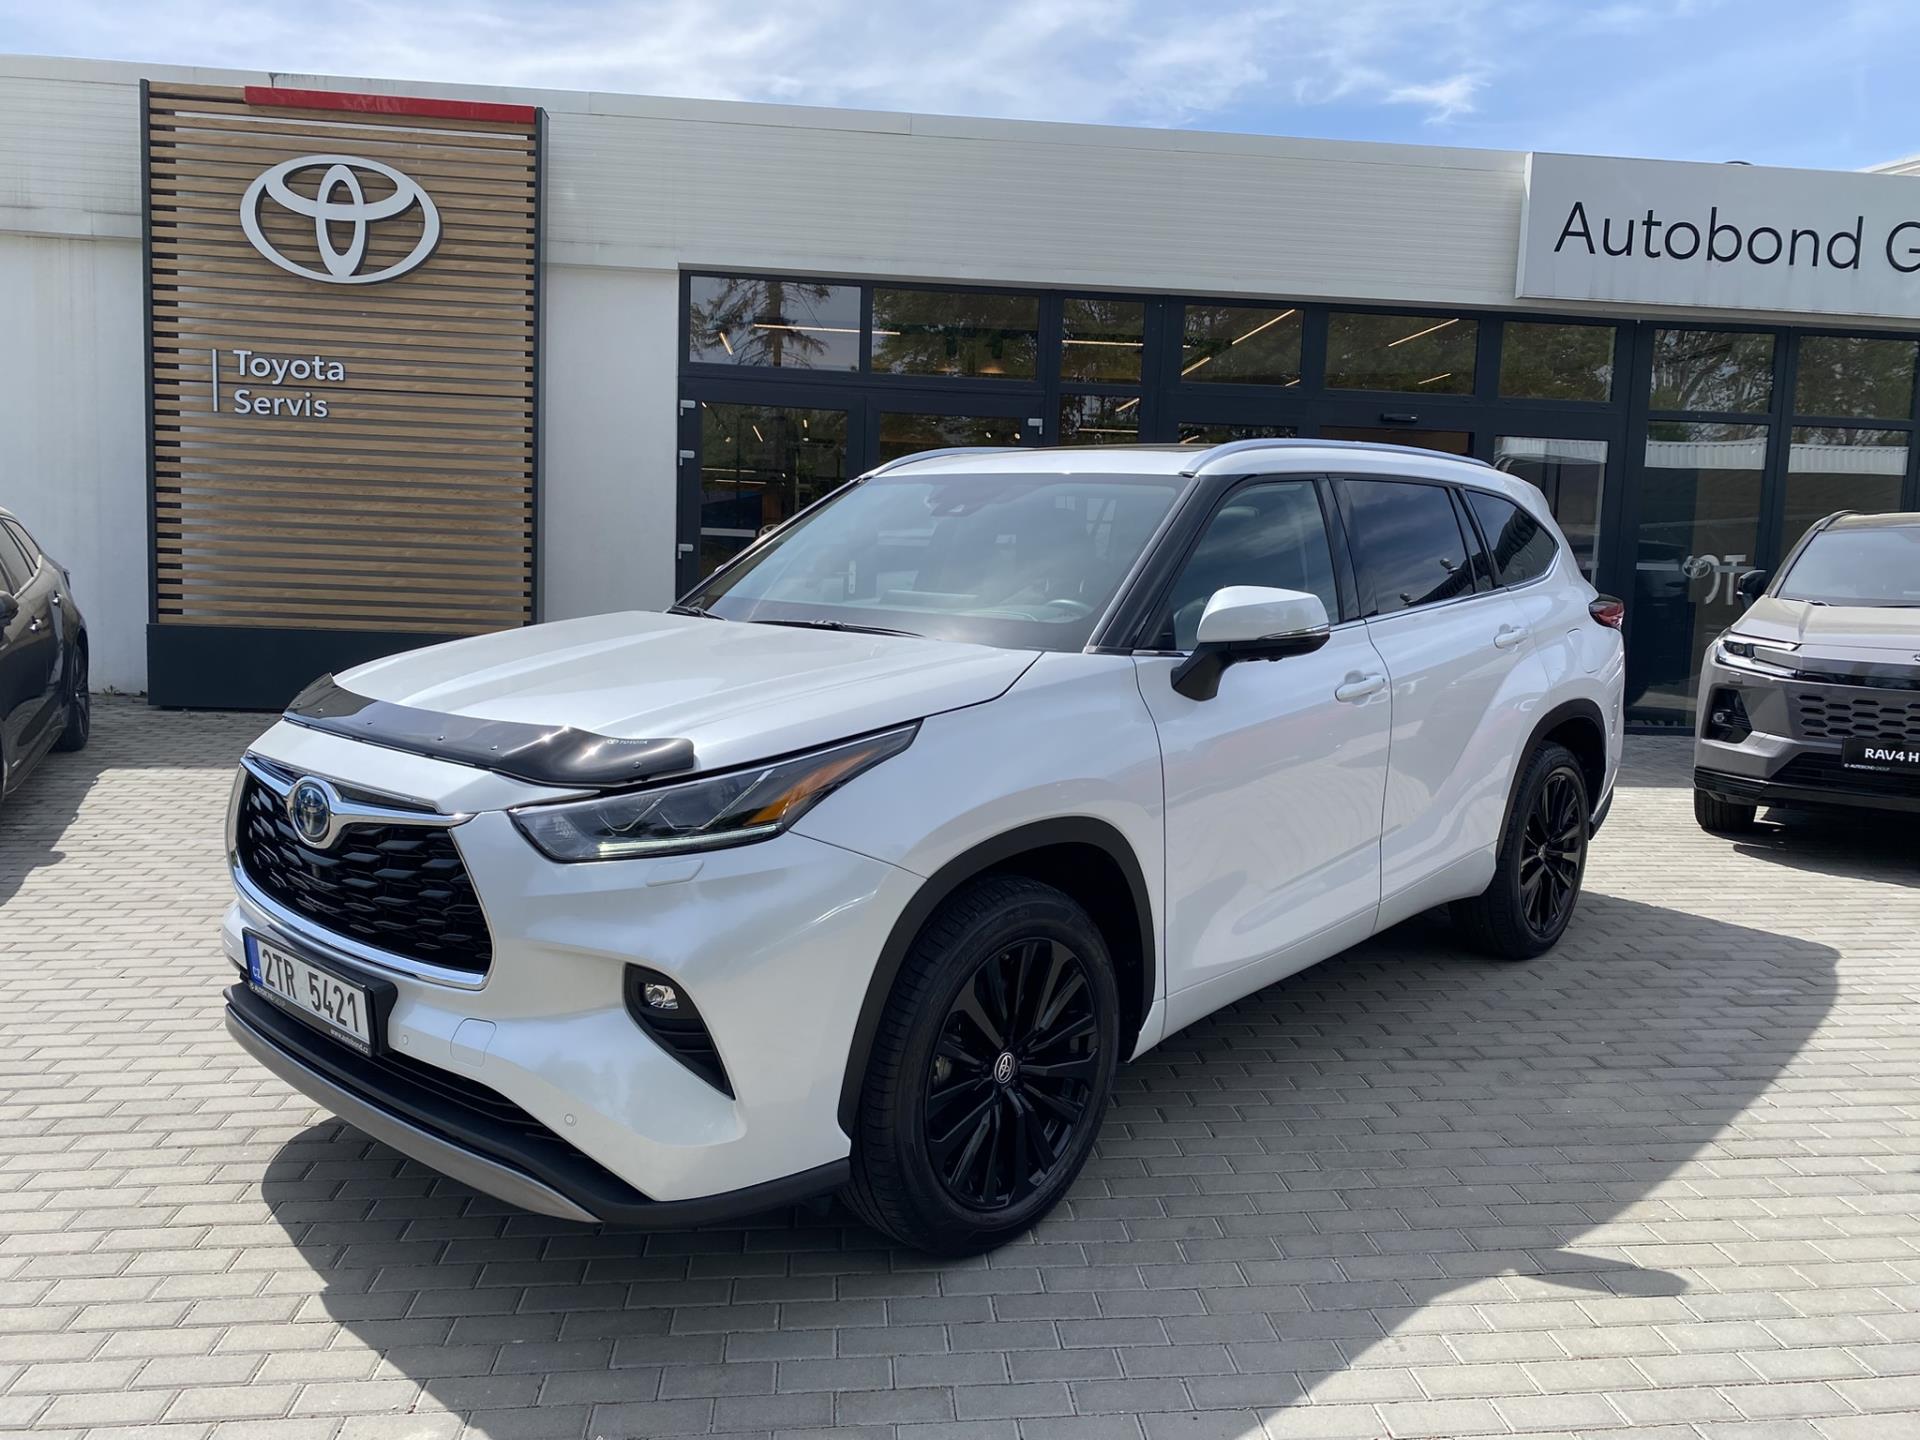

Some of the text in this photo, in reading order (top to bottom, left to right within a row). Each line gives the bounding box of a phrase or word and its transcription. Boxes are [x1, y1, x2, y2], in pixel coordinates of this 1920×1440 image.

[1554, 201, 1864, 271] Autobond
[233, 350, 345, 385] Toyota
[234, 389, 329, 418] Servis
[1864, 748, 1920, 763] RAV4 H
[262, 949, 359, 1034] 2TR 5421
